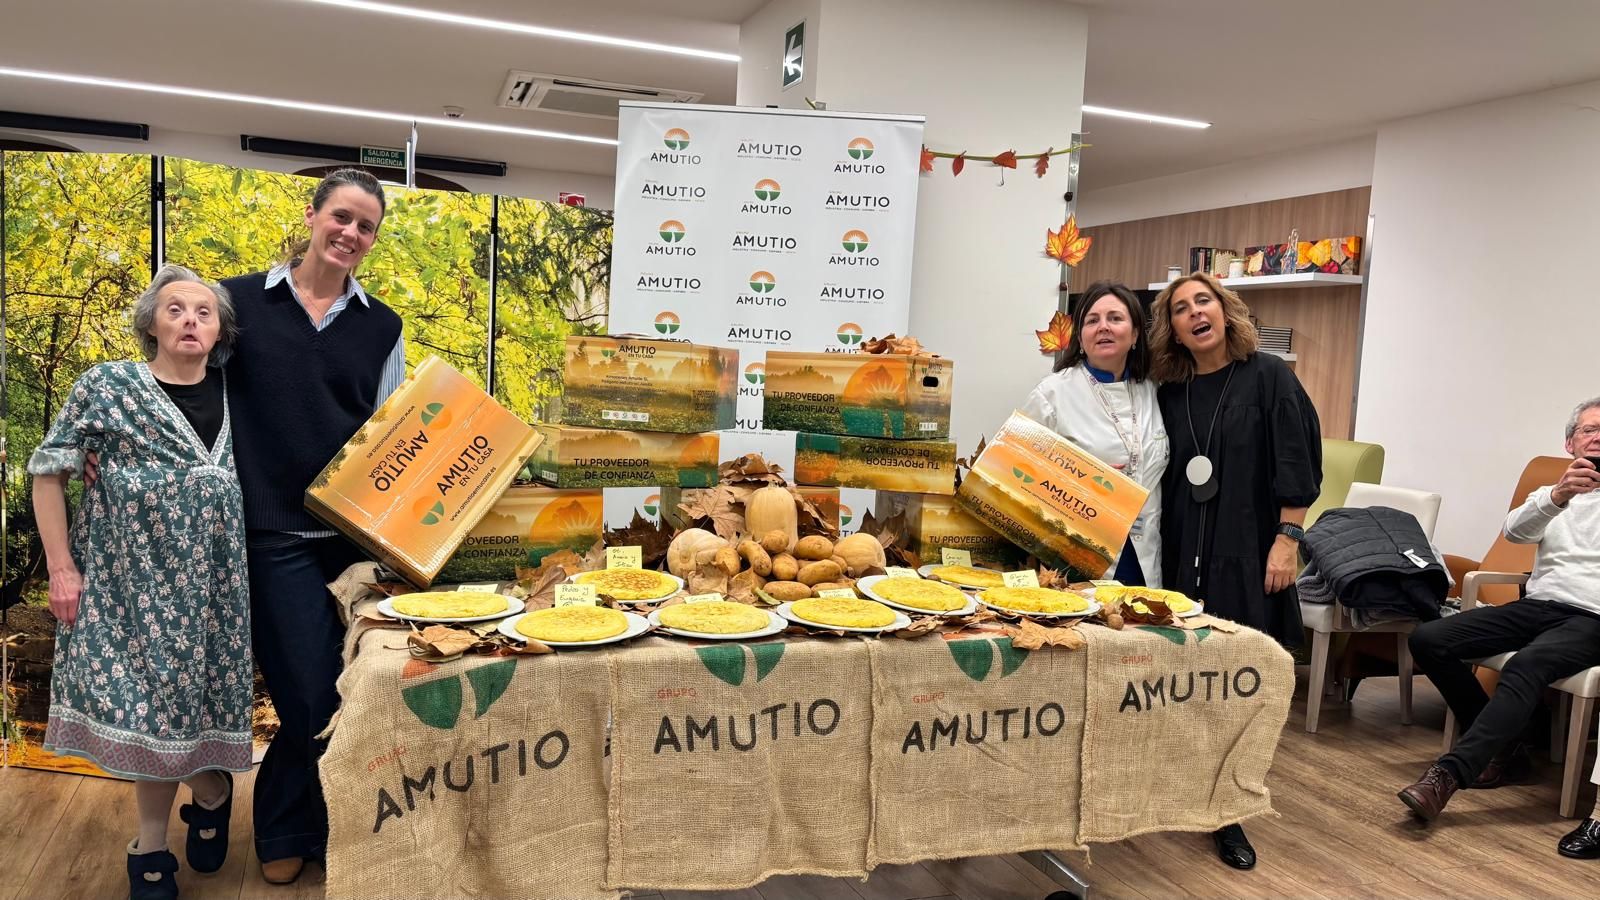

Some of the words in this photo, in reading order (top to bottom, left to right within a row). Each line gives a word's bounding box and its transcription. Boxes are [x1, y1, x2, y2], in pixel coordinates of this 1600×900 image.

[737, 143, 802, 156] AMUTIO
[364, 156, 402, 166] EMERGENCIA
[650, 152, 701, 165] AMUTIO
[834, 164, 885, 174] AMUTIO
[642, 184, 706, 198] AMUTIO
[825, 194, 890, 208] AMUTIO
[741, 204, 792, 215] AMUTIO
[732, 235, 797, 250] AMUTIO
[645, 246, 696, 256] AMUTIO
[829, 256, 880, 266] AMUTIO
[637, 276, 701, 290] AMUTIO
[820, 286, 884, 300] AMUTIO
[736, 296, 787, 307] AMUTIO
[727, 327, 792, 341] AMUTIO
[618, 344, 656, 355] AMUTIO
[772, 392, 783, 400] TU
[785, 392, 835, 402] PROVEEDOR
[781, 404, 792, 412] DE
[794, 404, 841, 414] CONFIANZA
[394, 438, 407, 451] EN
[860, 446, 915, 456] CONFIANZA
[385, 450, 397, 462] TU
[918, 449, 930, 458] DE
[374, 430, 430, 492] AMUTIO
[436, 435, 489, 496] AMUTIO
[458, 475, 471, 488] EN
[468, 466, 479, 477] TU
[477, 447, 494, 466] CASA
[574, 459, 586, 467] TU
[590, 458, 650, 468] PROVEEDOR
[866, 458, 924, 469] PROVEEDOR
[927, 462, 940, 470] TU
[368, 460, 388, 479] CASA
[584, 472, 599, 480] DE
[601, 472, 656, 480] CONFIANZA
[1040, 480, 1098, 518] AMUTIO
[975, 508, 988, 519] DE
[1051, 494, 1060, 503] EN
[1062, 502, 1072, 510] TU
[1073, 508, 1090, 522] CASA
[972, 495, 984, 506] TU
[984, 504, 1036, 540] PROVEEDOR
[464, 535, 520, 546] OVEEDOR
[929, 536, 940, 544] TU
[942, 536, 994, 544] PROVEEDOR
[464, 548, 528, 558] CONFIANZA
[1121, 654, 1153, 666] GRUPO
[657, 686, 698, 700] GRUPO
[1118, 666, 1262, 713] AMUTIO
[912, 690, 945, 704] GRUPO
[654, 698, 840, 755] AMUTIO
[901, 702, 1066, 755] AMUTIO
[372, 729, 570, 833] AMUTIO
